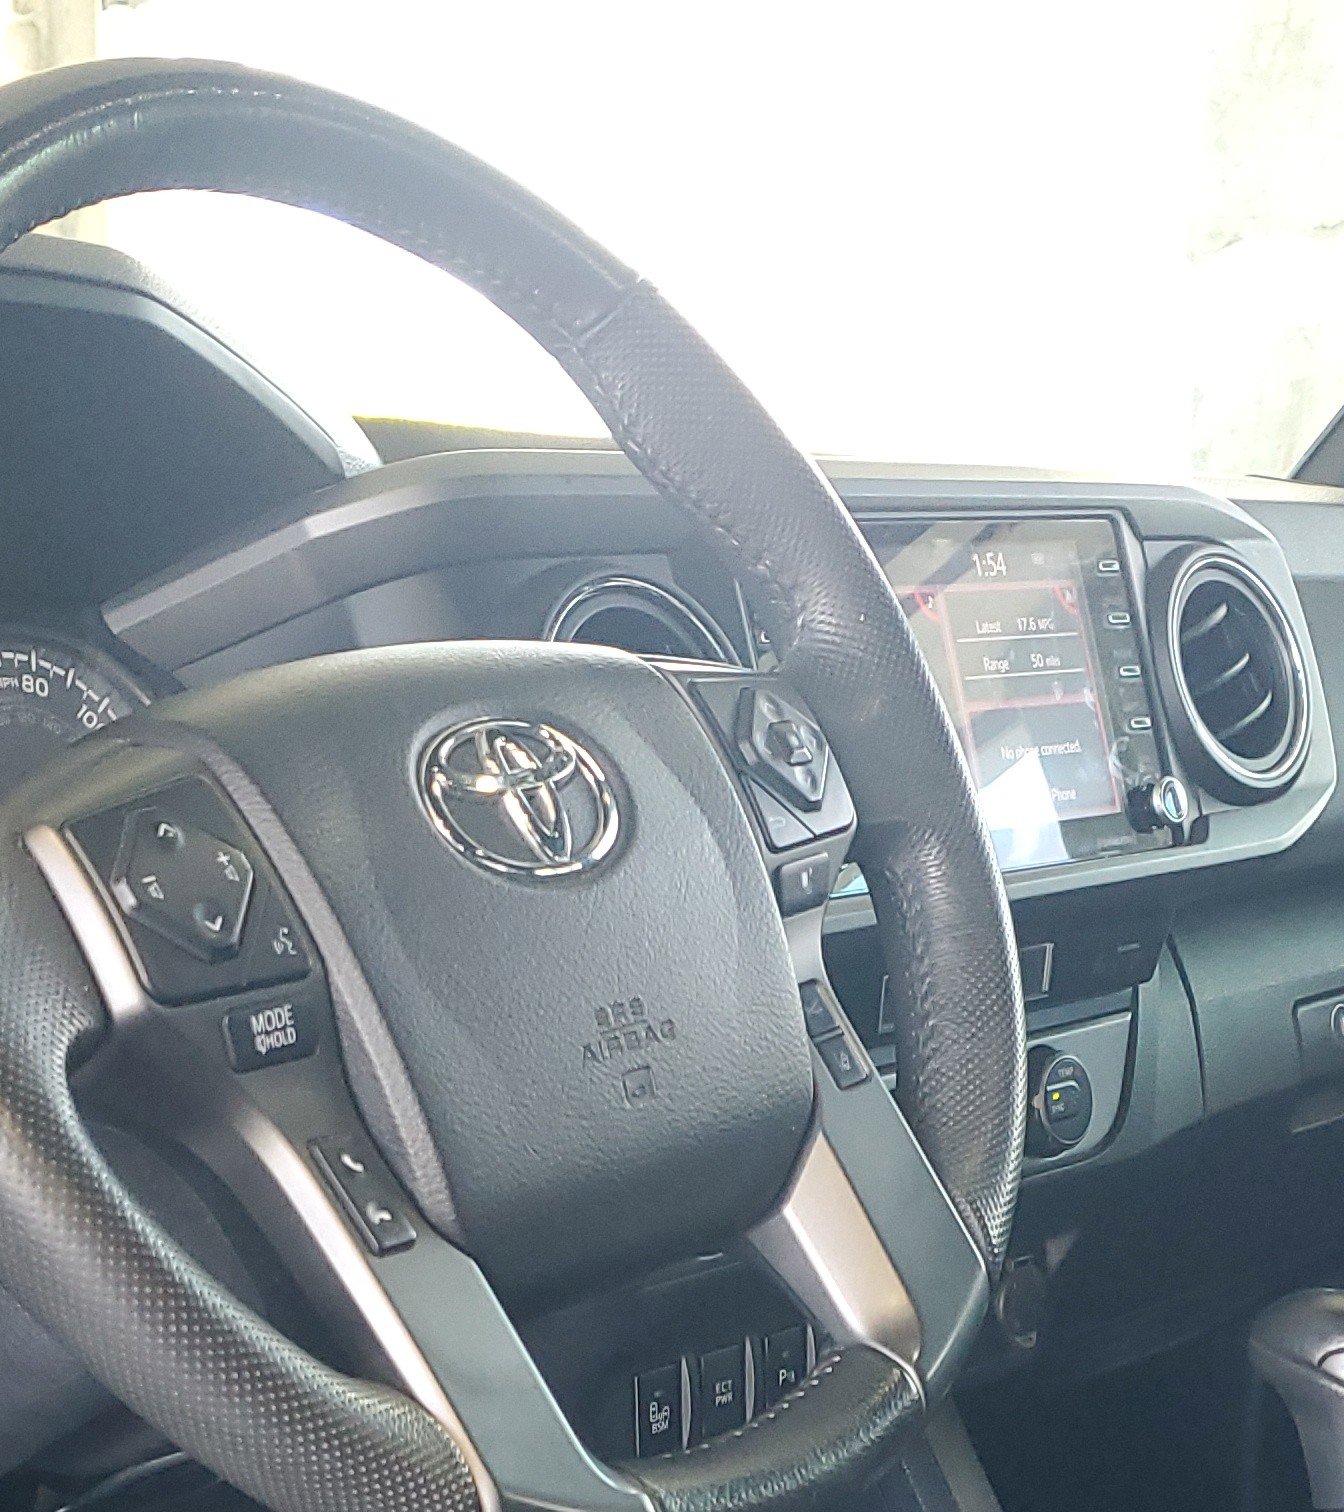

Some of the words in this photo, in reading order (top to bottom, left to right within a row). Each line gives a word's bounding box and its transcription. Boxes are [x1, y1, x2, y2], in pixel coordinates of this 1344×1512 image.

[972, 551, 1007, 577] 1:54
[1016, 617, 1037, 632] 17.6
[983, 656, 1010, 673] Range
[1029, 653, 1043, 669] 50
[21, 673, 50, 698] 80
[1000, 746, 1014, 760] No
[1051, 787, 1077, 801] Phone
[250, 1003, 295, 1035] MODE
[265, 1026, 297, 1050] HOLD
[582, 1018, 676, 1068] AIRBAG
[715, 1392, 733, 1407] PWR
[651, 1420, 669, 1435] BSM
